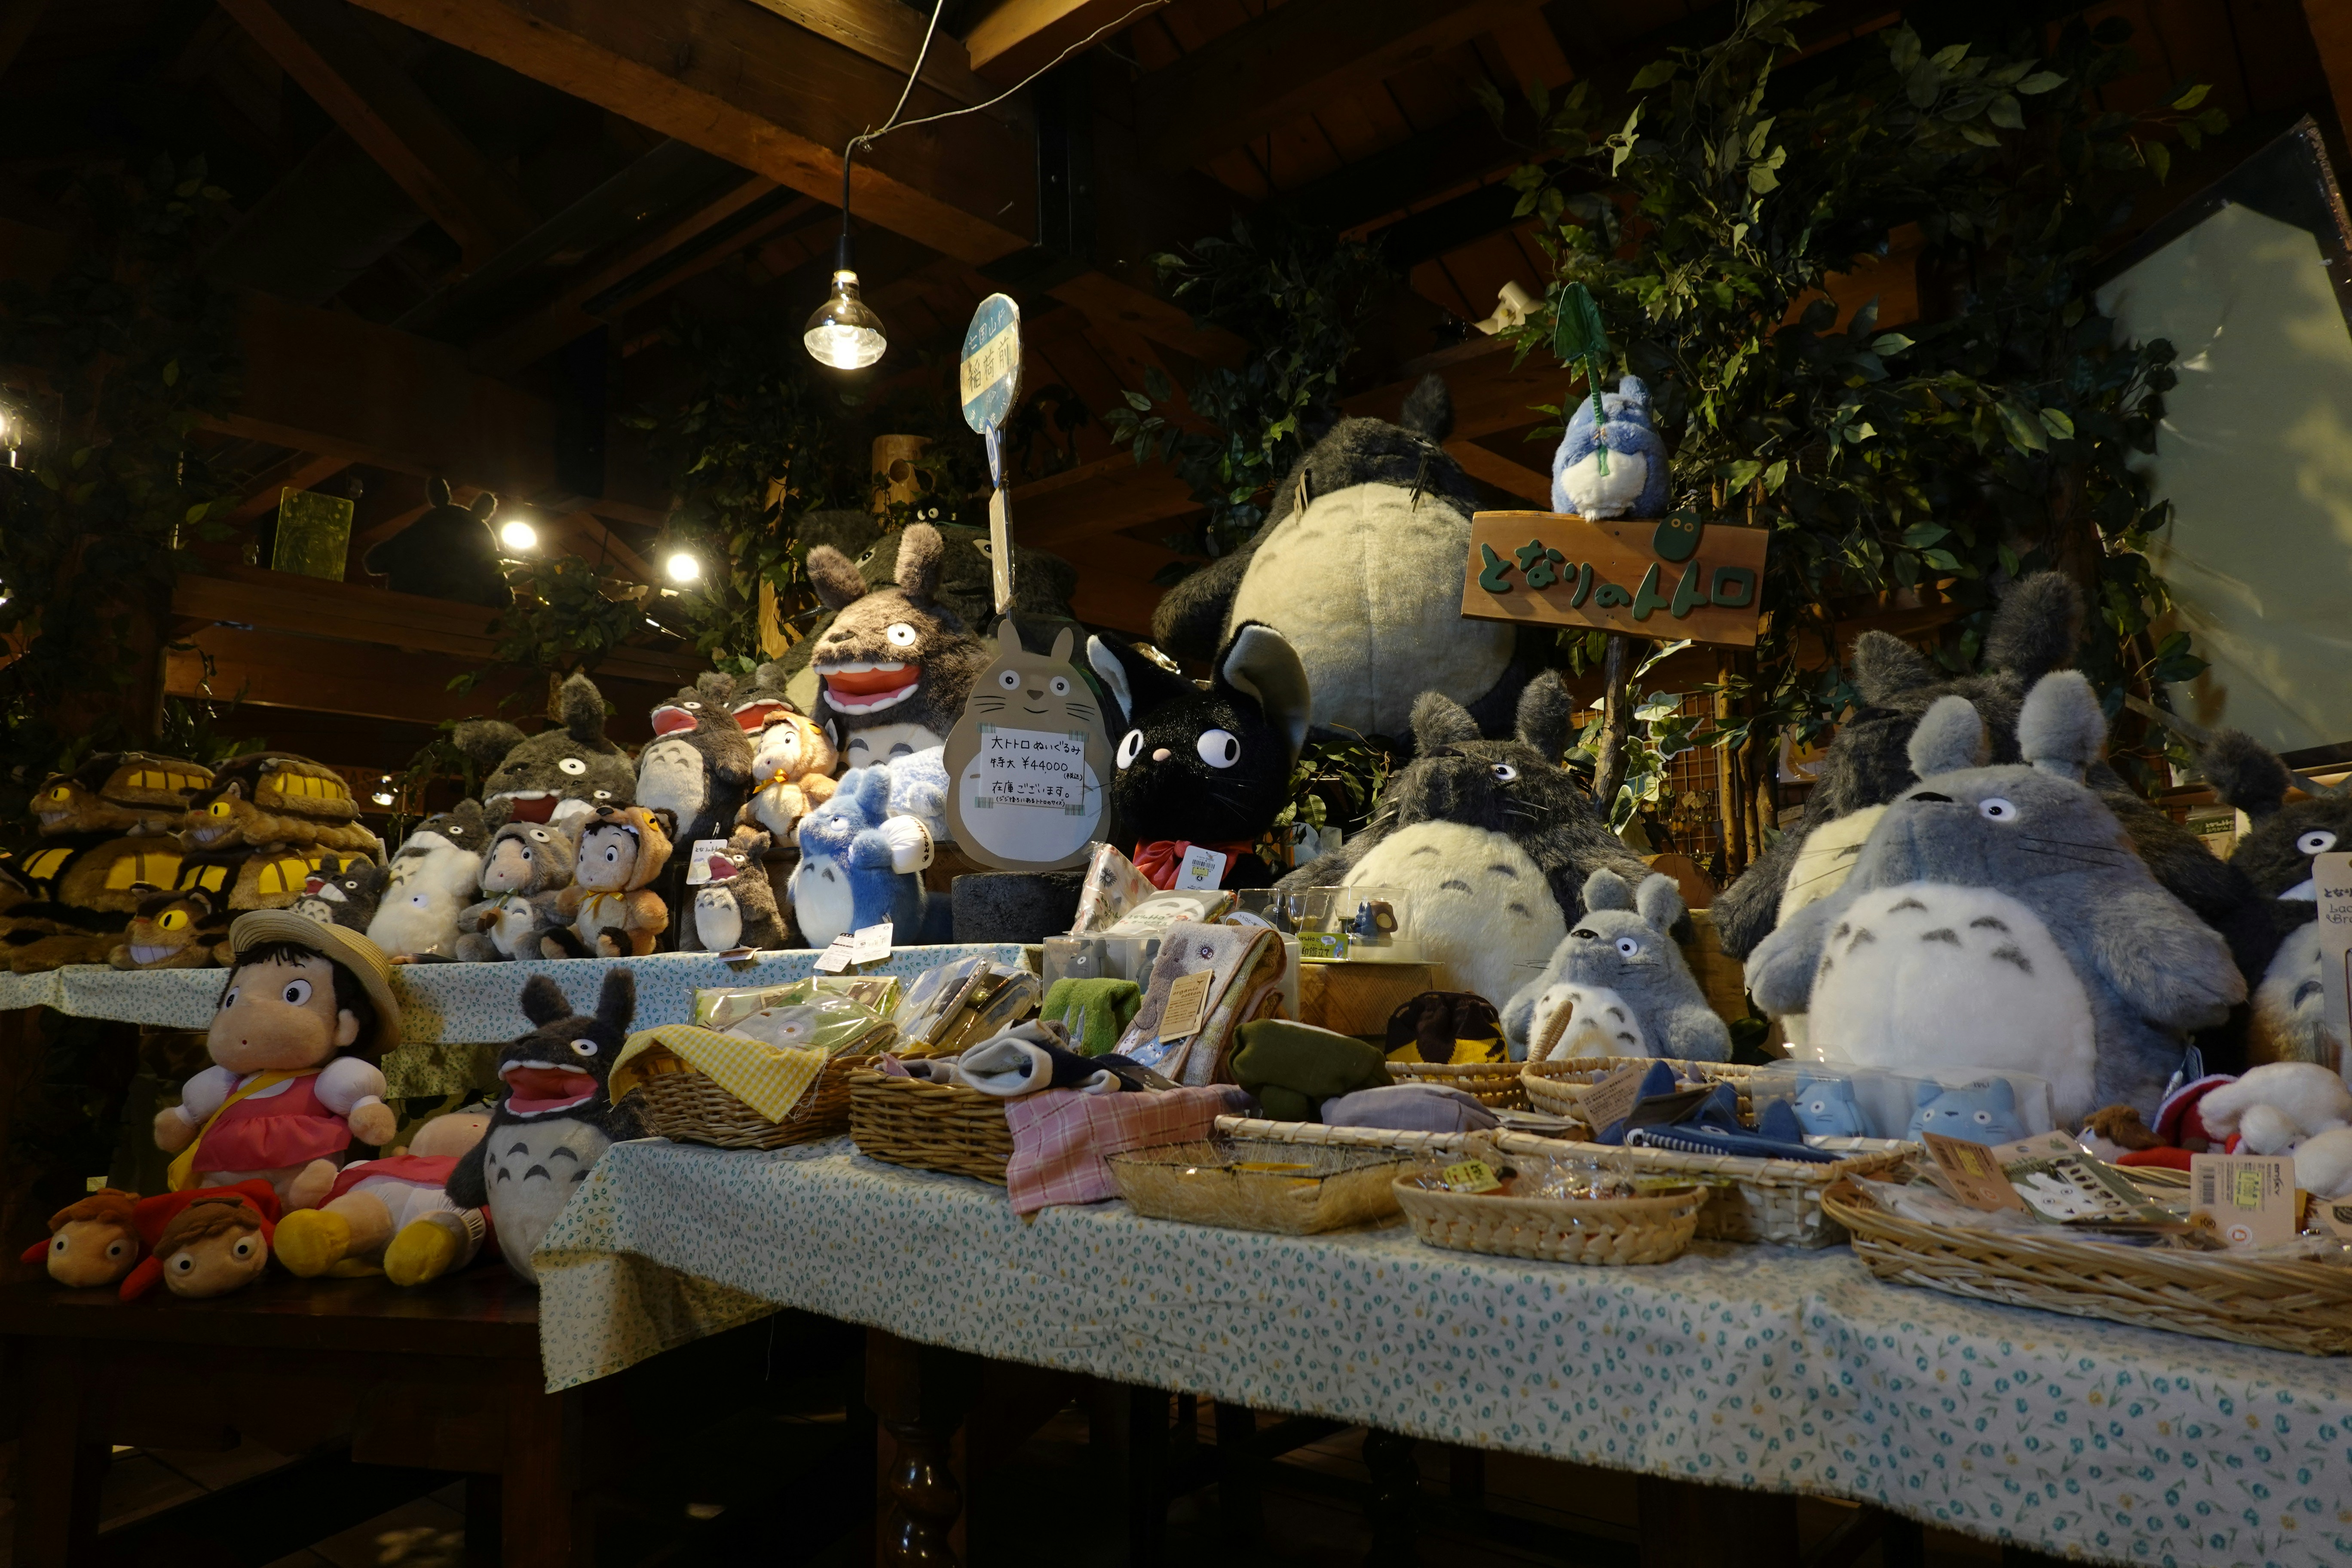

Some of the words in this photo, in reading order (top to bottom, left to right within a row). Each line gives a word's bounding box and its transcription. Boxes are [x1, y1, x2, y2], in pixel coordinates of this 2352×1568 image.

[968, 336, 1009, 392] 稲荷前
[1479, 539, 1755, 620] となりのトトロ
[990, 757, 1016, 769] 特大
[1173, 986, 1199, 996] organic
[1181, 990, 1202, 998] cotton
